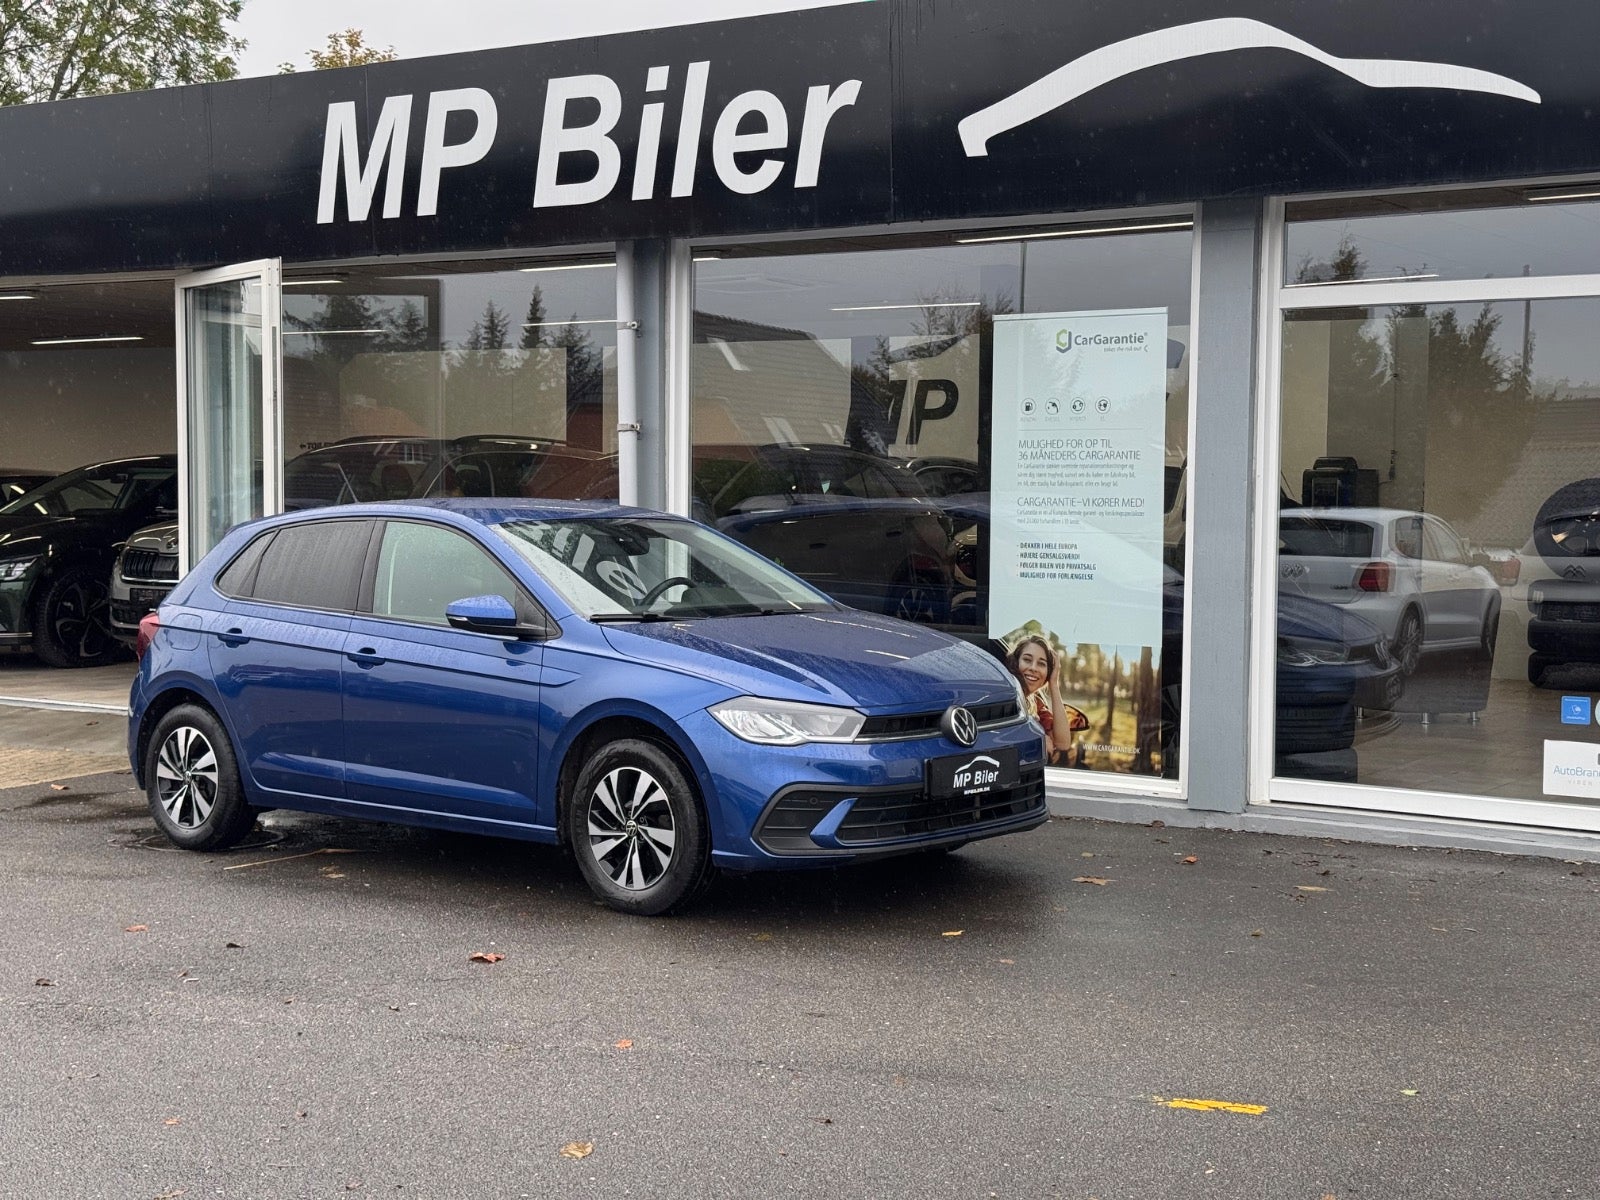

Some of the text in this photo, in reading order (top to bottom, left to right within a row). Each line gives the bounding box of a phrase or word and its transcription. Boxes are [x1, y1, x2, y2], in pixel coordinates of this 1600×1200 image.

[316, 60, 863, 225] MP Biler
[1018, 438, 1113, 449] MULIGHED FOR OP TIL
[1018, 448, 1141, 460] 36 MÅNEDERS CARGARANTIE
[1017, 497, 1075, 507] CARGARANTIE
[1091, 497, 1120, 508] KØRER
[1121, 498, 1145, 508] MED!
[1553, 765, 1600, 778] AutoBran
[953, 769, 999, 788] MP Biler
